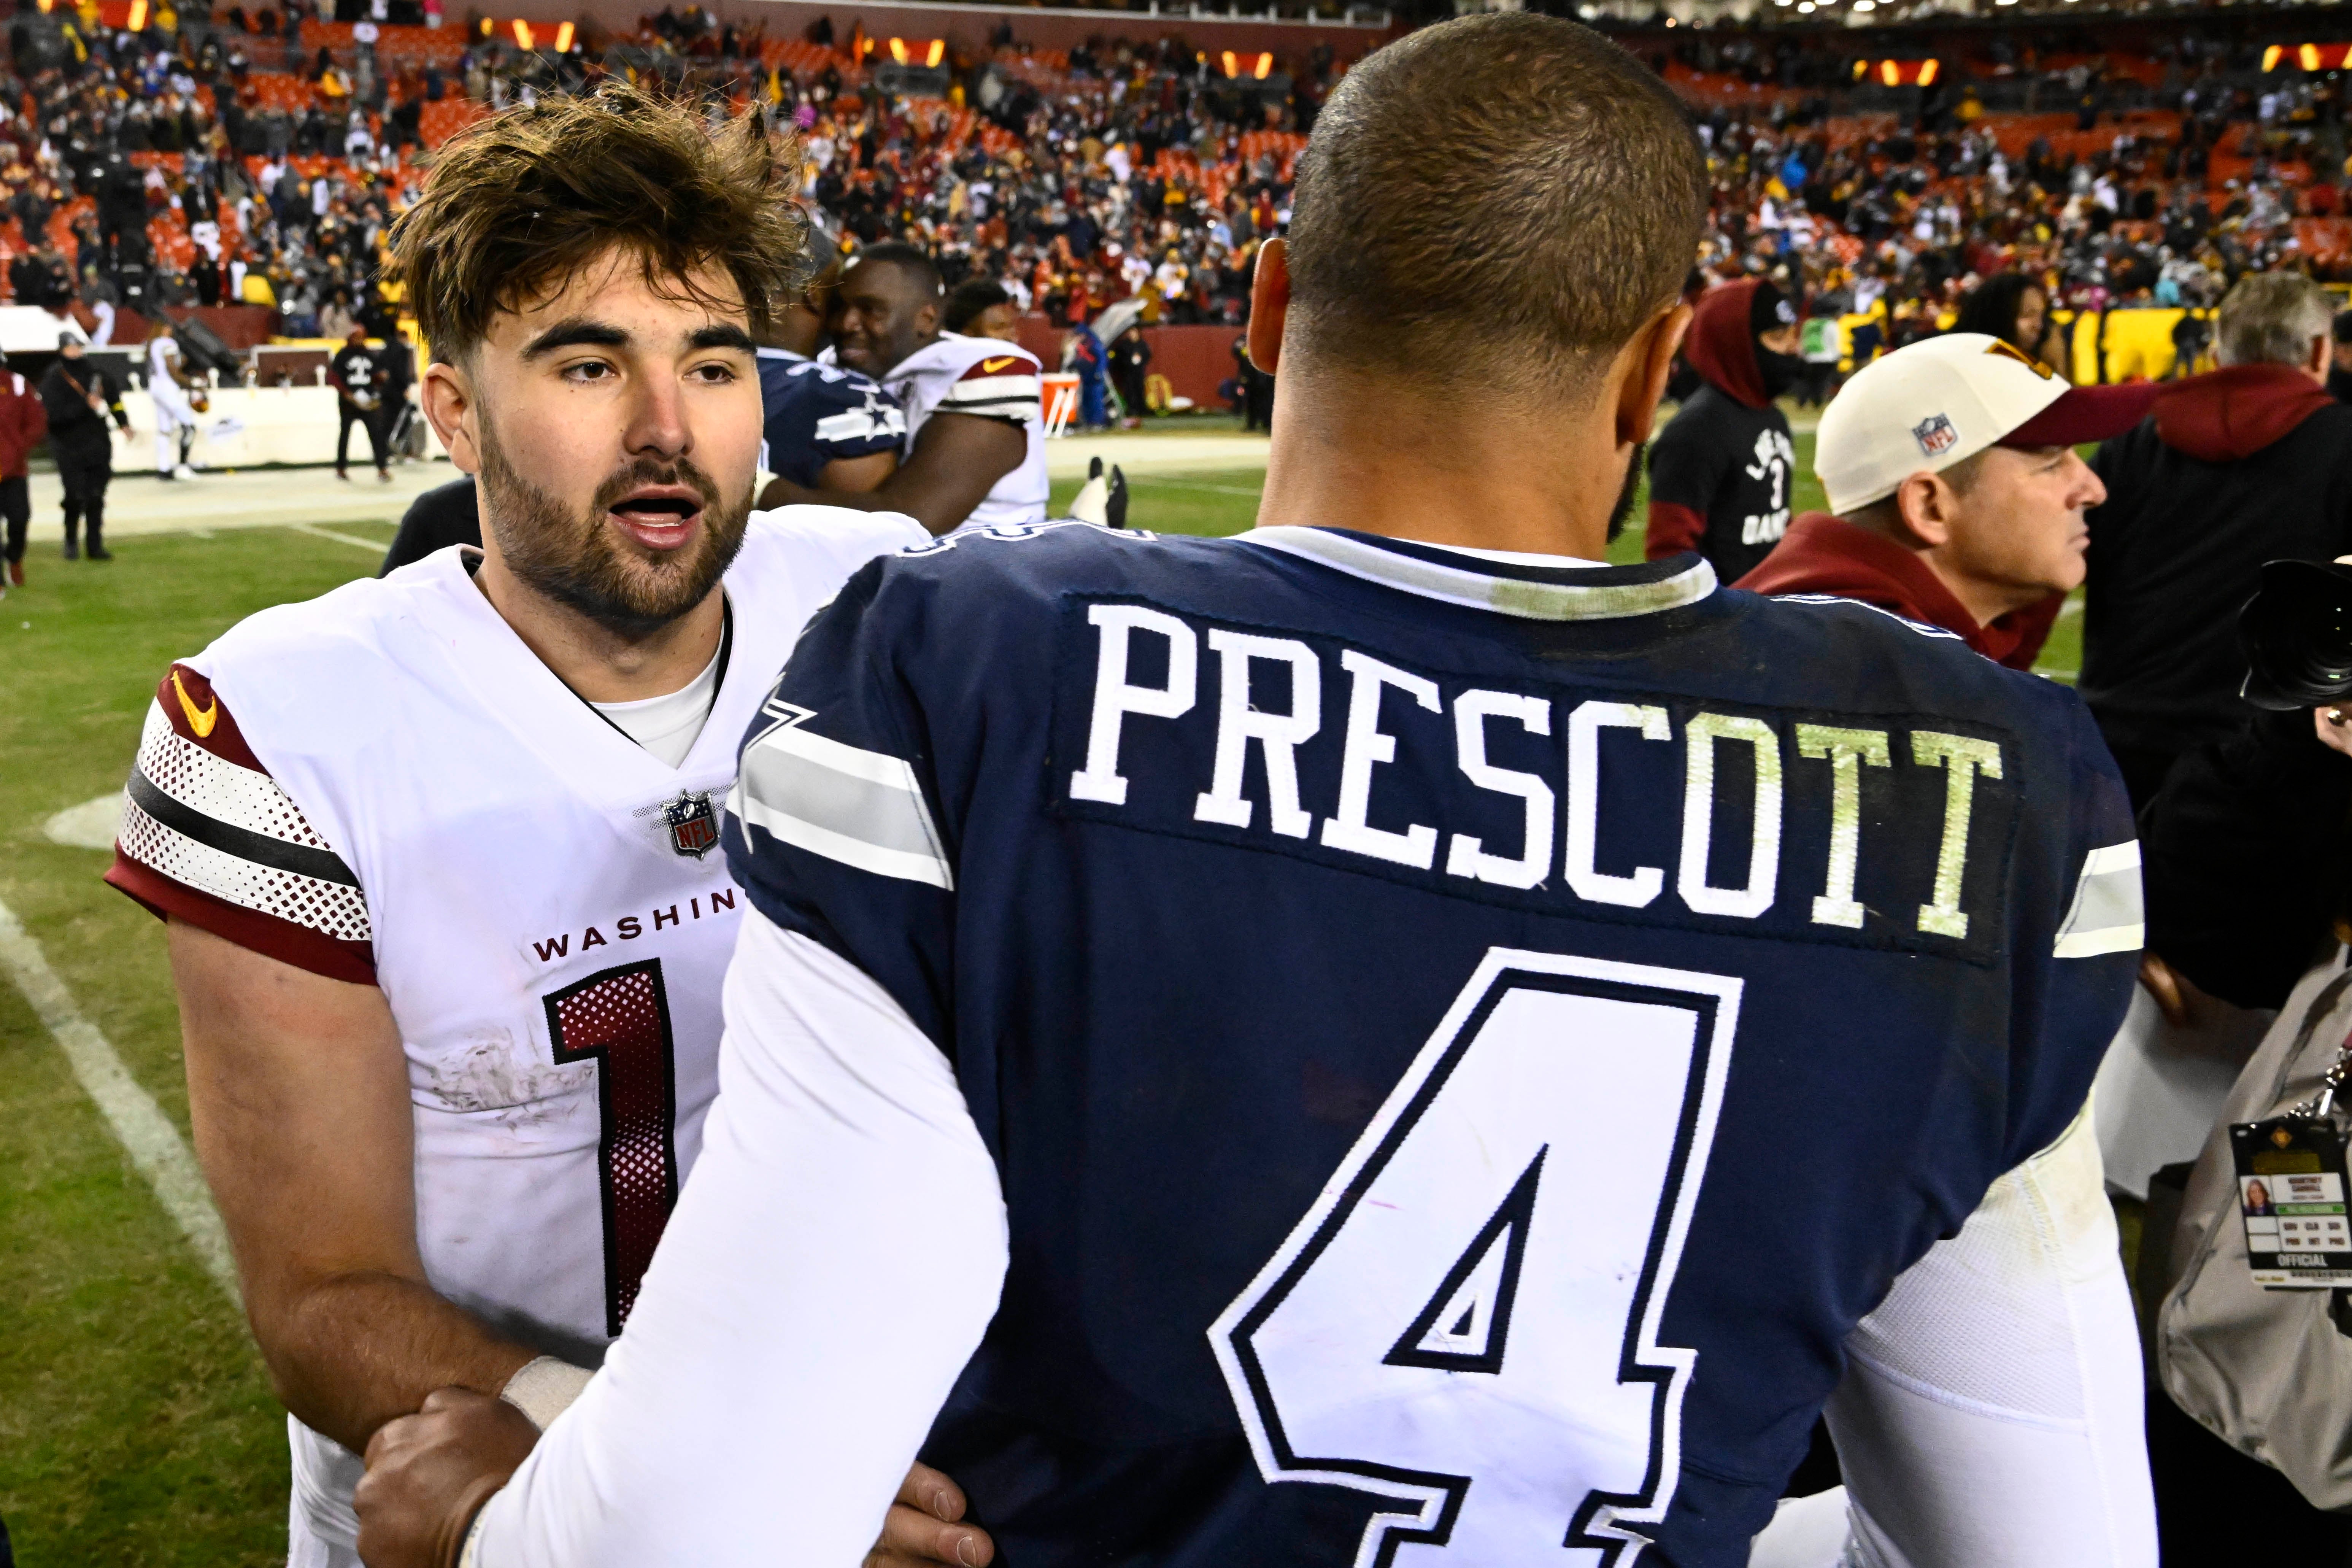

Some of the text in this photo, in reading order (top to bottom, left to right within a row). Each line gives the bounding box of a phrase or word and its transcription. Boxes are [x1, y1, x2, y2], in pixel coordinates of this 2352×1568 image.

[1742, 507, 1790, 545] DAM
[1069, 604, 2003, 939] PRESCOTT
[675, 818, 714, 848] NFL
[532, 888, 735, 962] WASHIN
[542, 957, 678, 1337] 1
[1206, 946, 1744, 1568] 4
[2277, 1254, 2328, 1267] OFFICIAL
